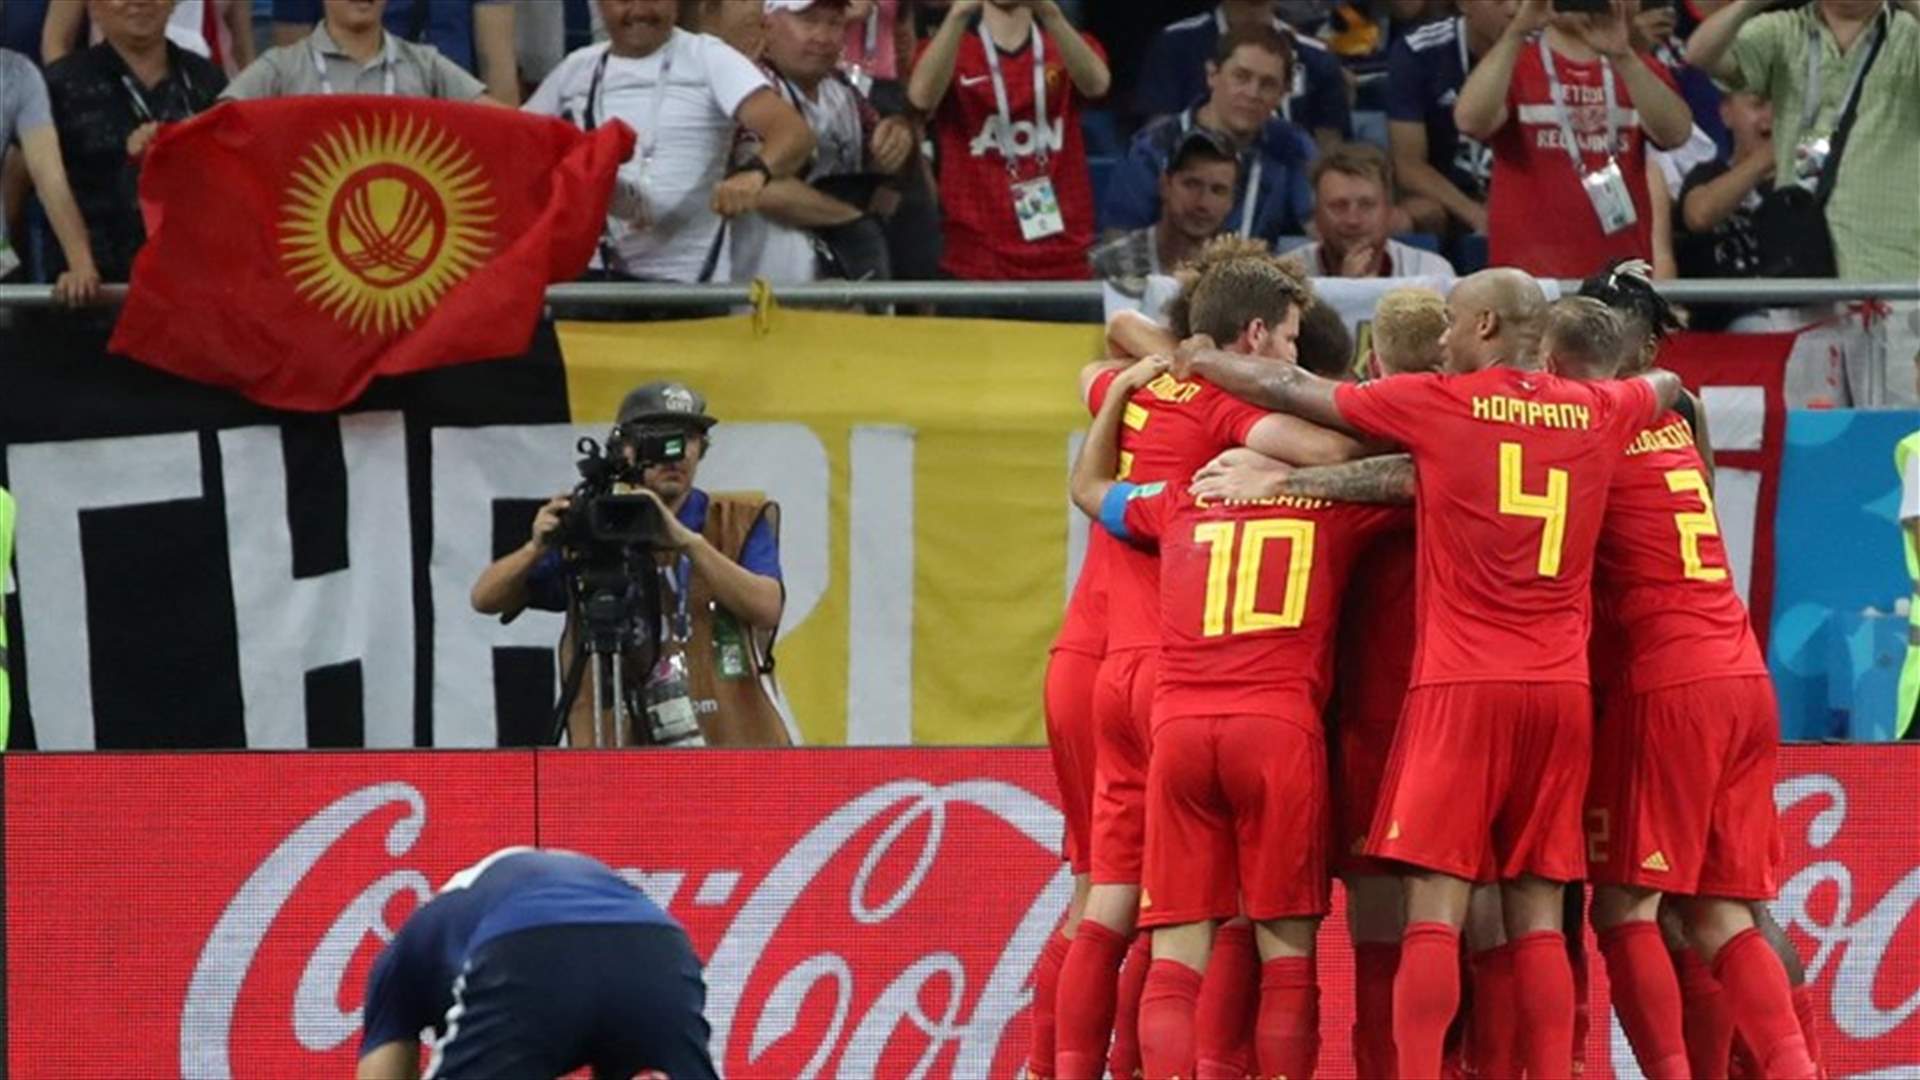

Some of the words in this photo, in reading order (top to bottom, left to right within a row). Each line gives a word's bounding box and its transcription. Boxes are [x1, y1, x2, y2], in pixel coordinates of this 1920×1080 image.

[969, 114, 1064, 156] AON
[1473, 395, 1590, 430] KOMPANY
[1499, 442, 1568, 578] 4
[1664, 468, 1727, 582] 2
[1194, 518, 1315, 637] 10
